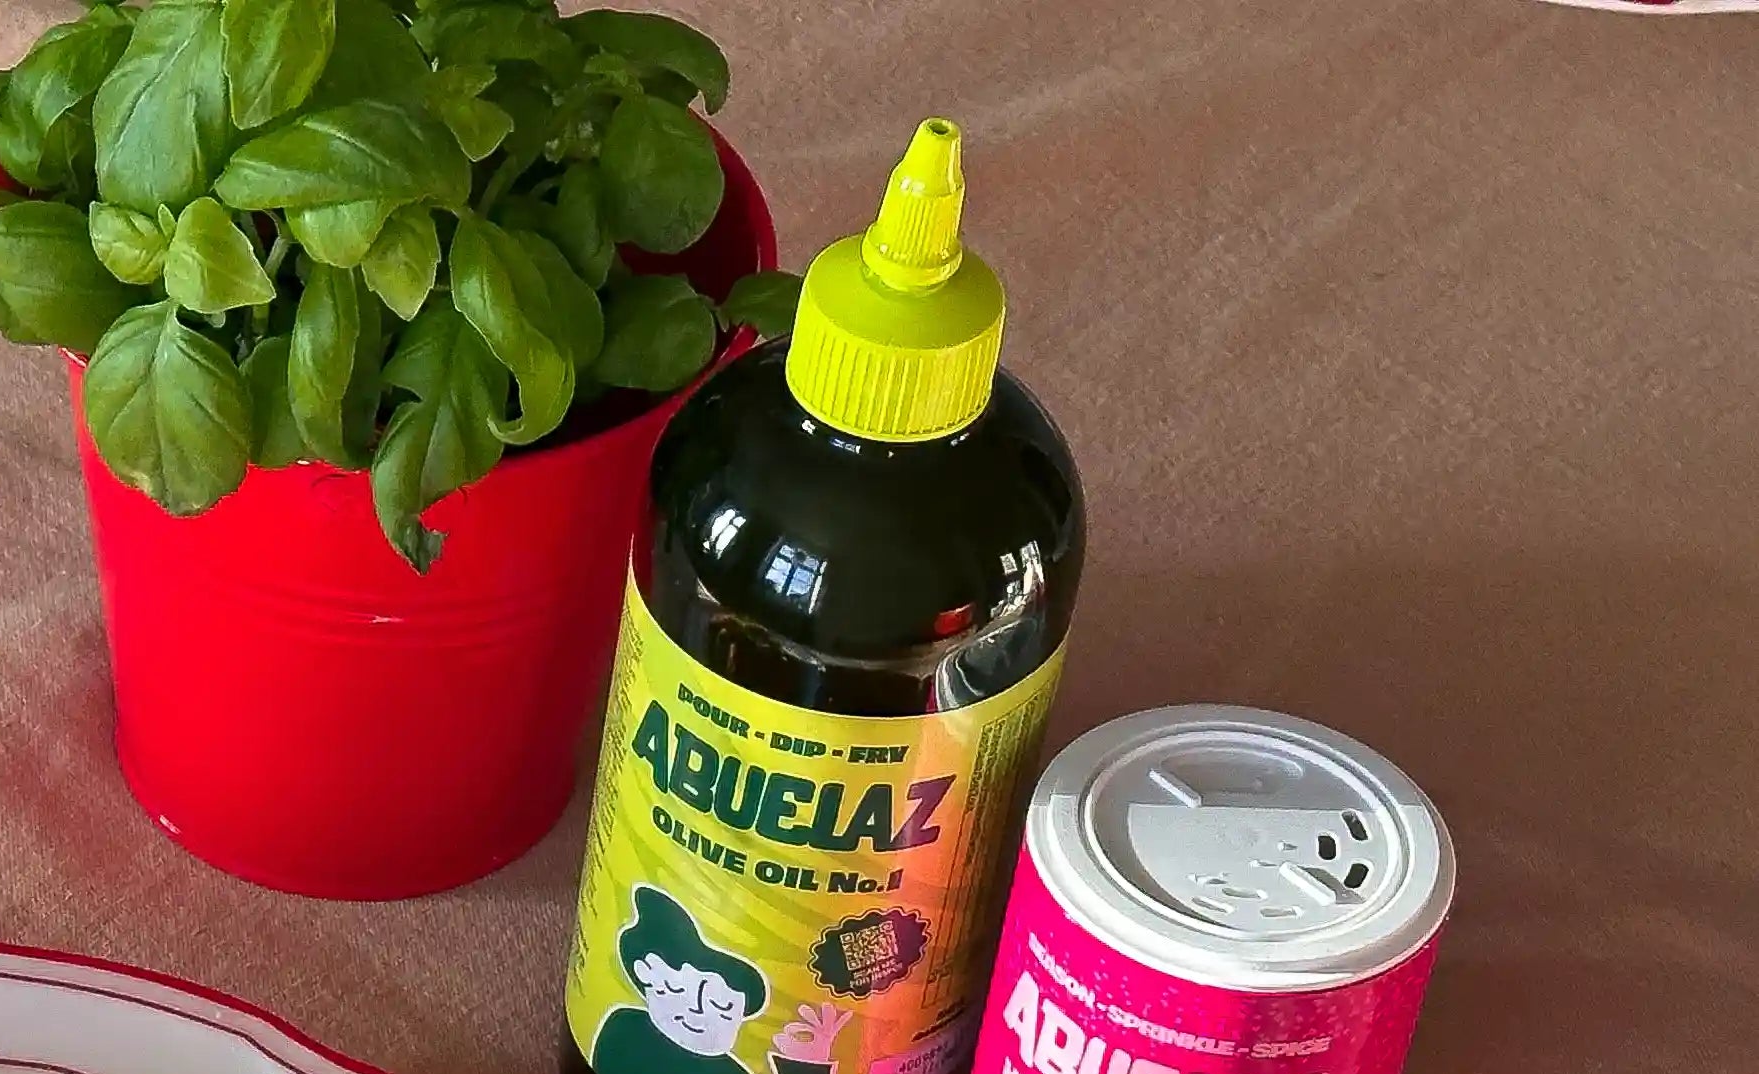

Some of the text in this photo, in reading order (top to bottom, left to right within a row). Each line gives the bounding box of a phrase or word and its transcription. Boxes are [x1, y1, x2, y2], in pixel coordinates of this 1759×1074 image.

[676, 681, 751, 740] POUR
[770, 731, 827, 758] DIP
[848, 745, 911, 765] FRY
[631, 699, 958, 852] ABUELAZ
[651, 805, 748, 876] OLIVE
[754, 860, 820, 893] OIL
